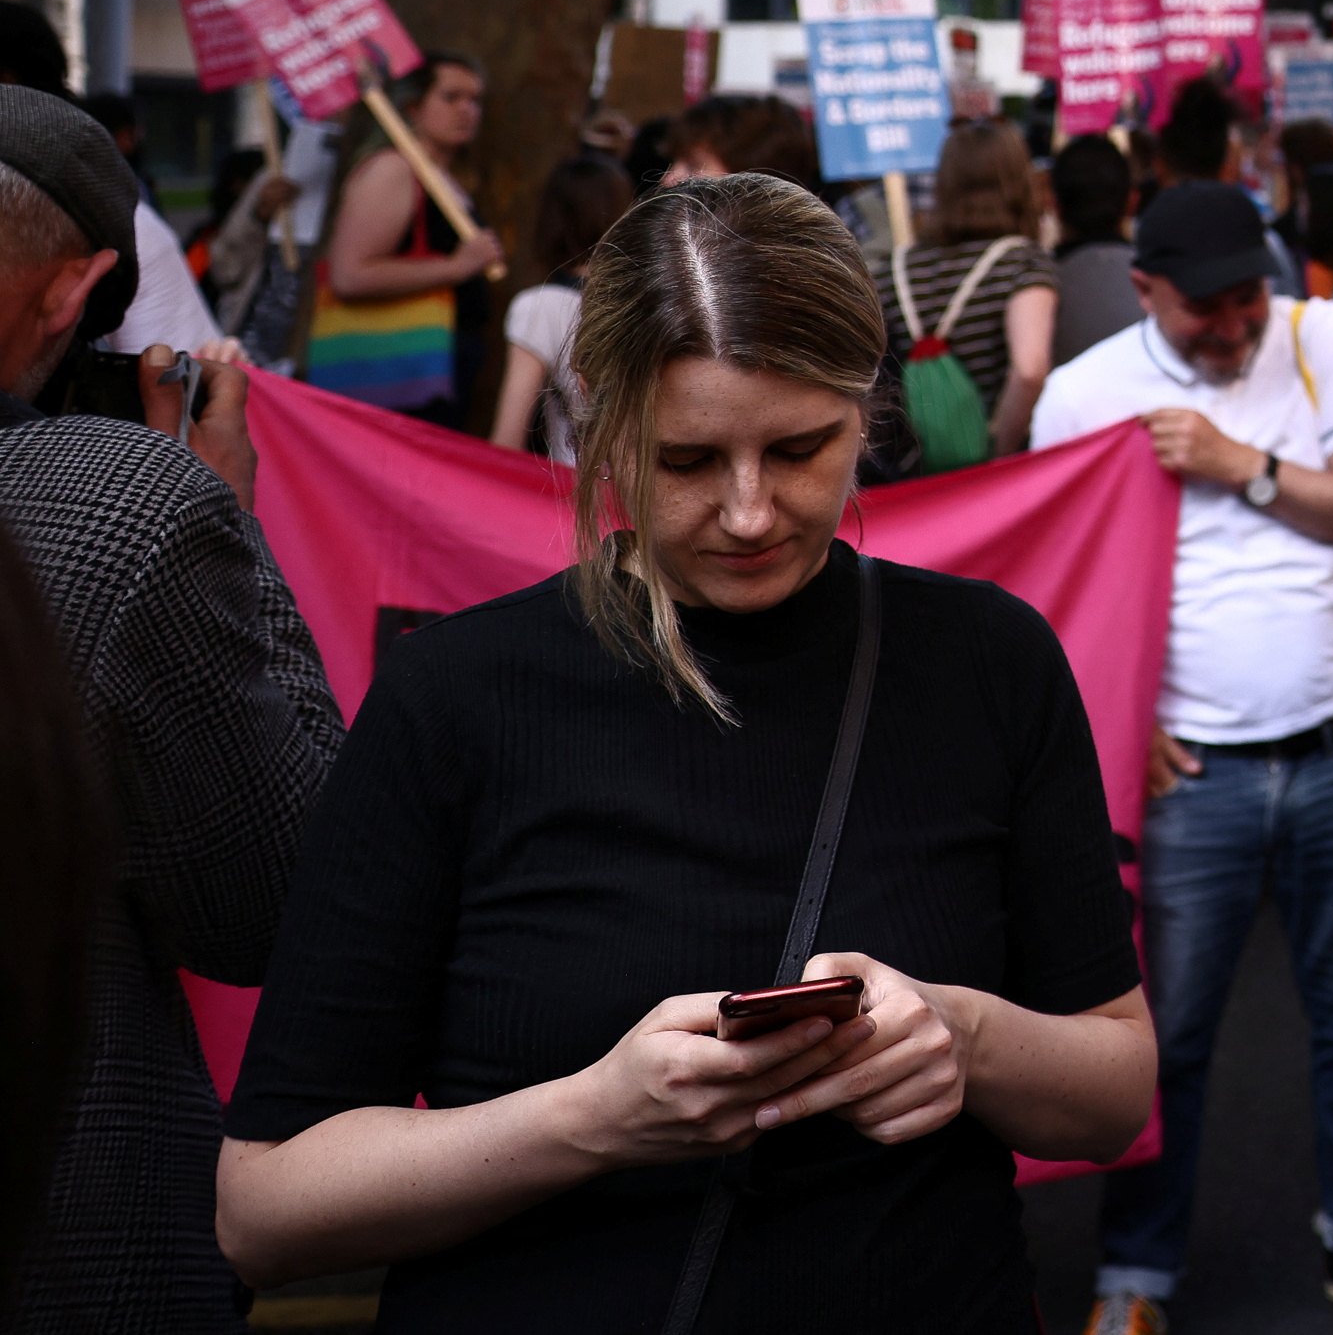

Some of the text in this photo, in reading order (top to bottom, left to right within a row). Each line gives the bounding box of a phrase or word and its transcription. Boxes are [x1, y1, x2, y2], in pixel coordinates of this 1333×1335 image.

[280, 9, 381, 71] welcome
[819, 39, 930, 68] Scrap the
[291, 57, 347, 95] here
[1061, 49, 1162, 76] welcome
[814, 67, 940, 95] Nationality
[1062, 77, 1120, 105] here
[826, 96, 941, 125] & Borders
[866, 125, 909, 152] Bill
